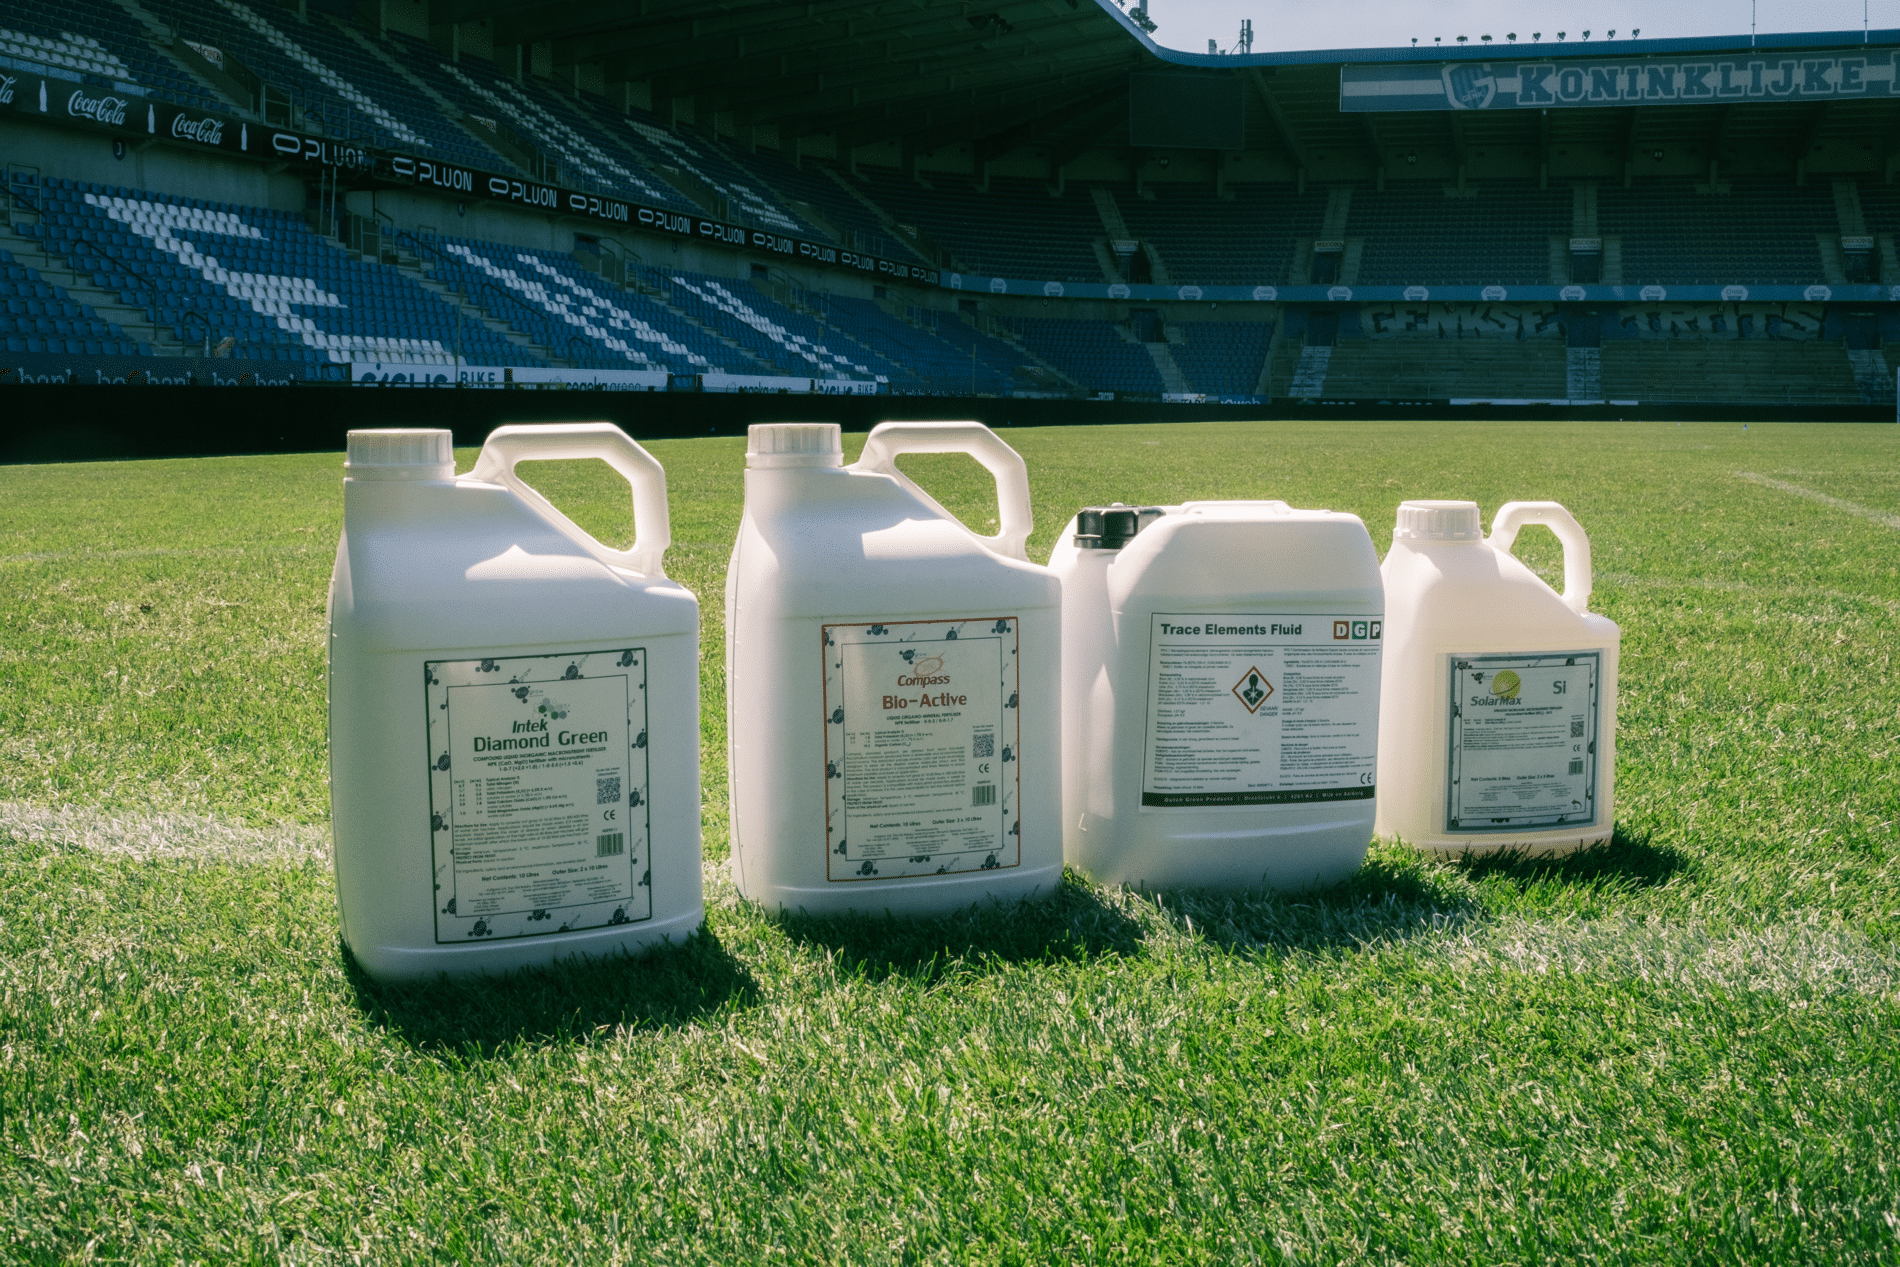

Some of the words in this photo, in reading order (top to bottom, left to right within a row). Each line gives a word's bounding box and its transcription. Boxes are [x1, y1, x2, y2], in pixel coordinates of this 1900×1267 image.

[1516, 57, 1867, 105] KONINKLIJKE
[68, 90, 128, 126] Coca-Cola
[172, 112, 225, 145] Coca-Cola
[419, 161, 473, 192] PLUON
[511, 181, 558, 209] PLUON
[588, 198, 629, 222] PLUON
[655, 211, 691, 235] PLUON
[714, 224, 746, 245] PLUON
[766, 234, 794, 255] PLUON
[811, 245, 836, 264] PLUON
[851, 255, 875, 272] PLUON
[1160, 623, 1201, 635] Trace
[1205, 623, 1267, 635] Elements
[1270, 623, 1302, 635] Fluid
[897, 674, 950, 688] Compass
[1552, 680, 1567, 694] Si
[882, 692, 967, 709] Bio-Active
[1470, 695, 1522, 706] SolarMax
[512, 719, 549, 733] Intek
[473, 733, 550, 753] Diamond
[558, 730, 608, 747] Green
[1360, 772, 1372, 784] CE
